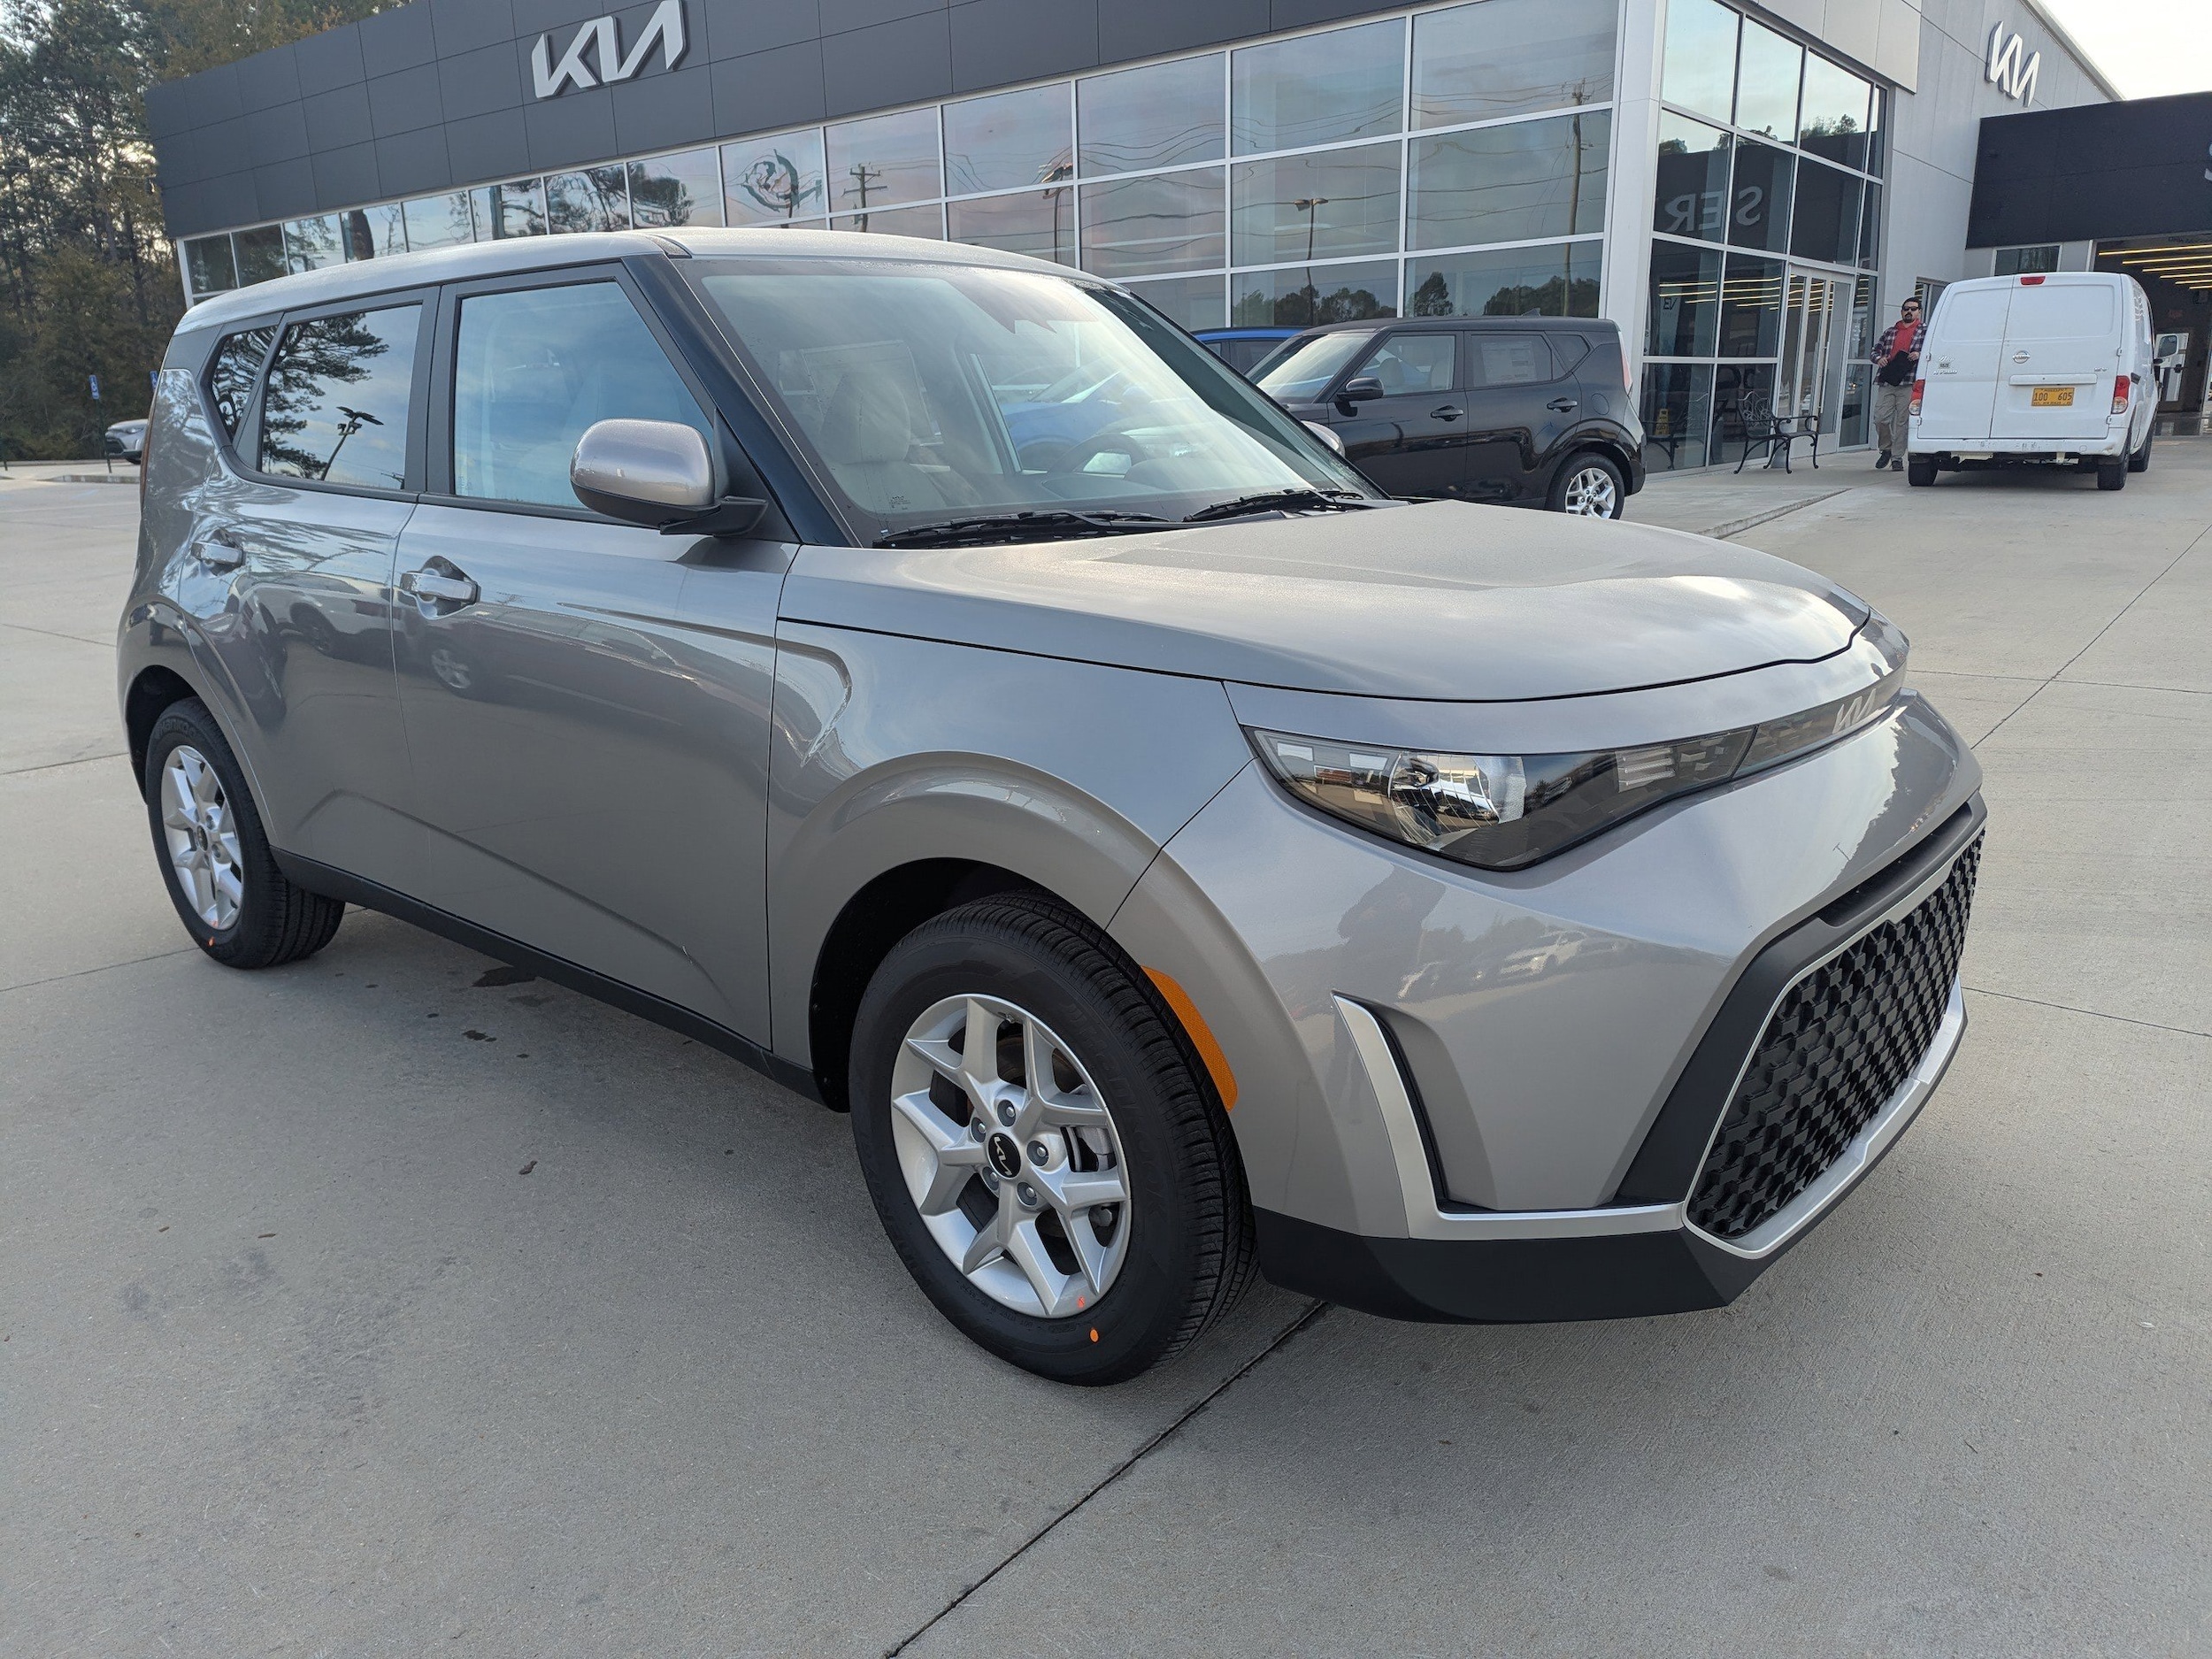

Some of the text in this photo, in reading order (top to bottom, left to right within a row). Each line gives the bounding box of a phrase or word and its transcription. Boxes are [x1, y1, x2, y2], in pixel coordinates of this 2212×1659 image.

[532, 0, 686, 98] KIA
[2033, 391, 2072, 402] 100 605
